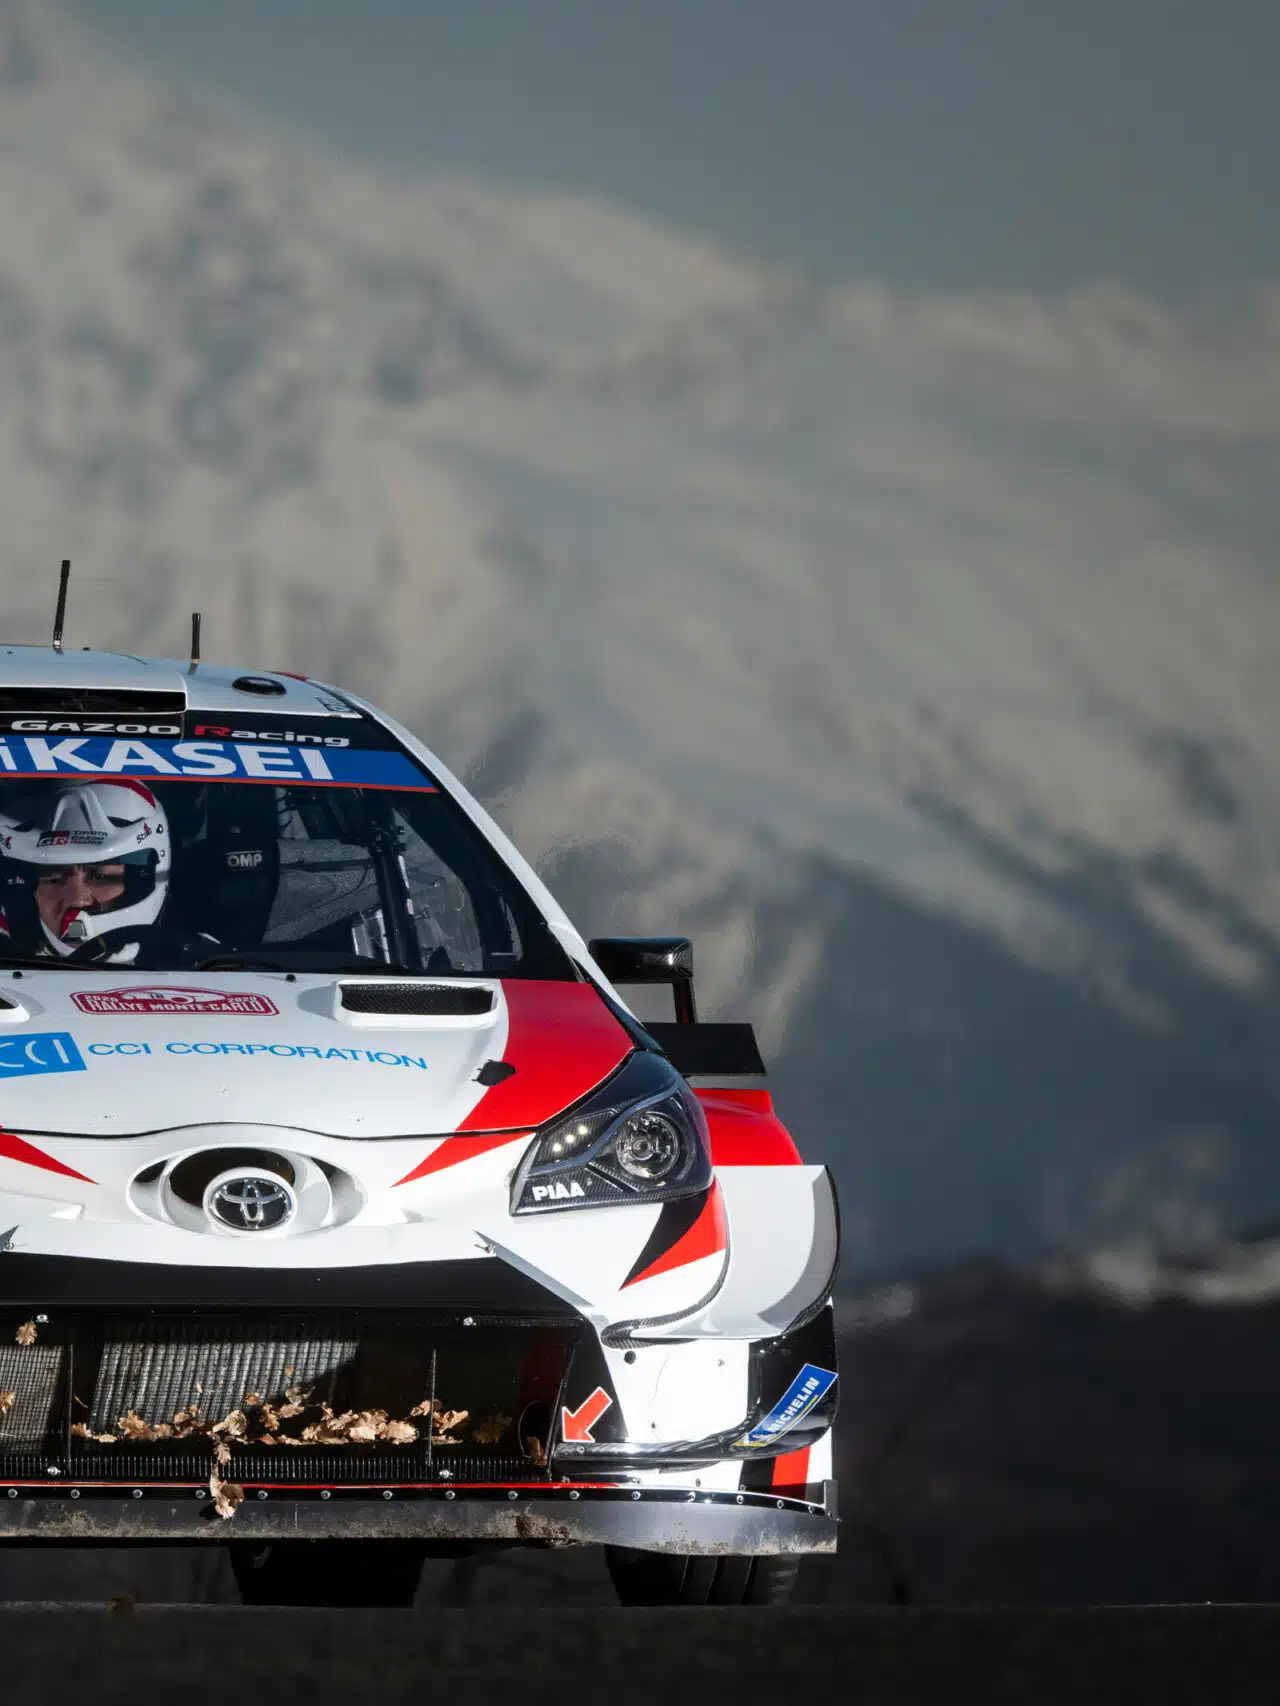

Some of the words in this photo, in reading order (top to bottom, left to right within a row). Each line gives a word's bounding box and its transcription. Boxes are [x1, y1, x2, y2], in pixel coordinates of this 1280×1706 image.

[11, 719, 181, 735] GAZOO
[194, 725, 350, 748] Racing
[227, 853, 263, 868] OMP
[86, 999, 147, 1012] RALLYE
[88, 1043, 153, 1056] CCI
[166, 1042, 428, 1070] CORPORATION
[532, 1181, 585, 1201] PIAA
[767, 1376, 820, 1433] MICHELIN
